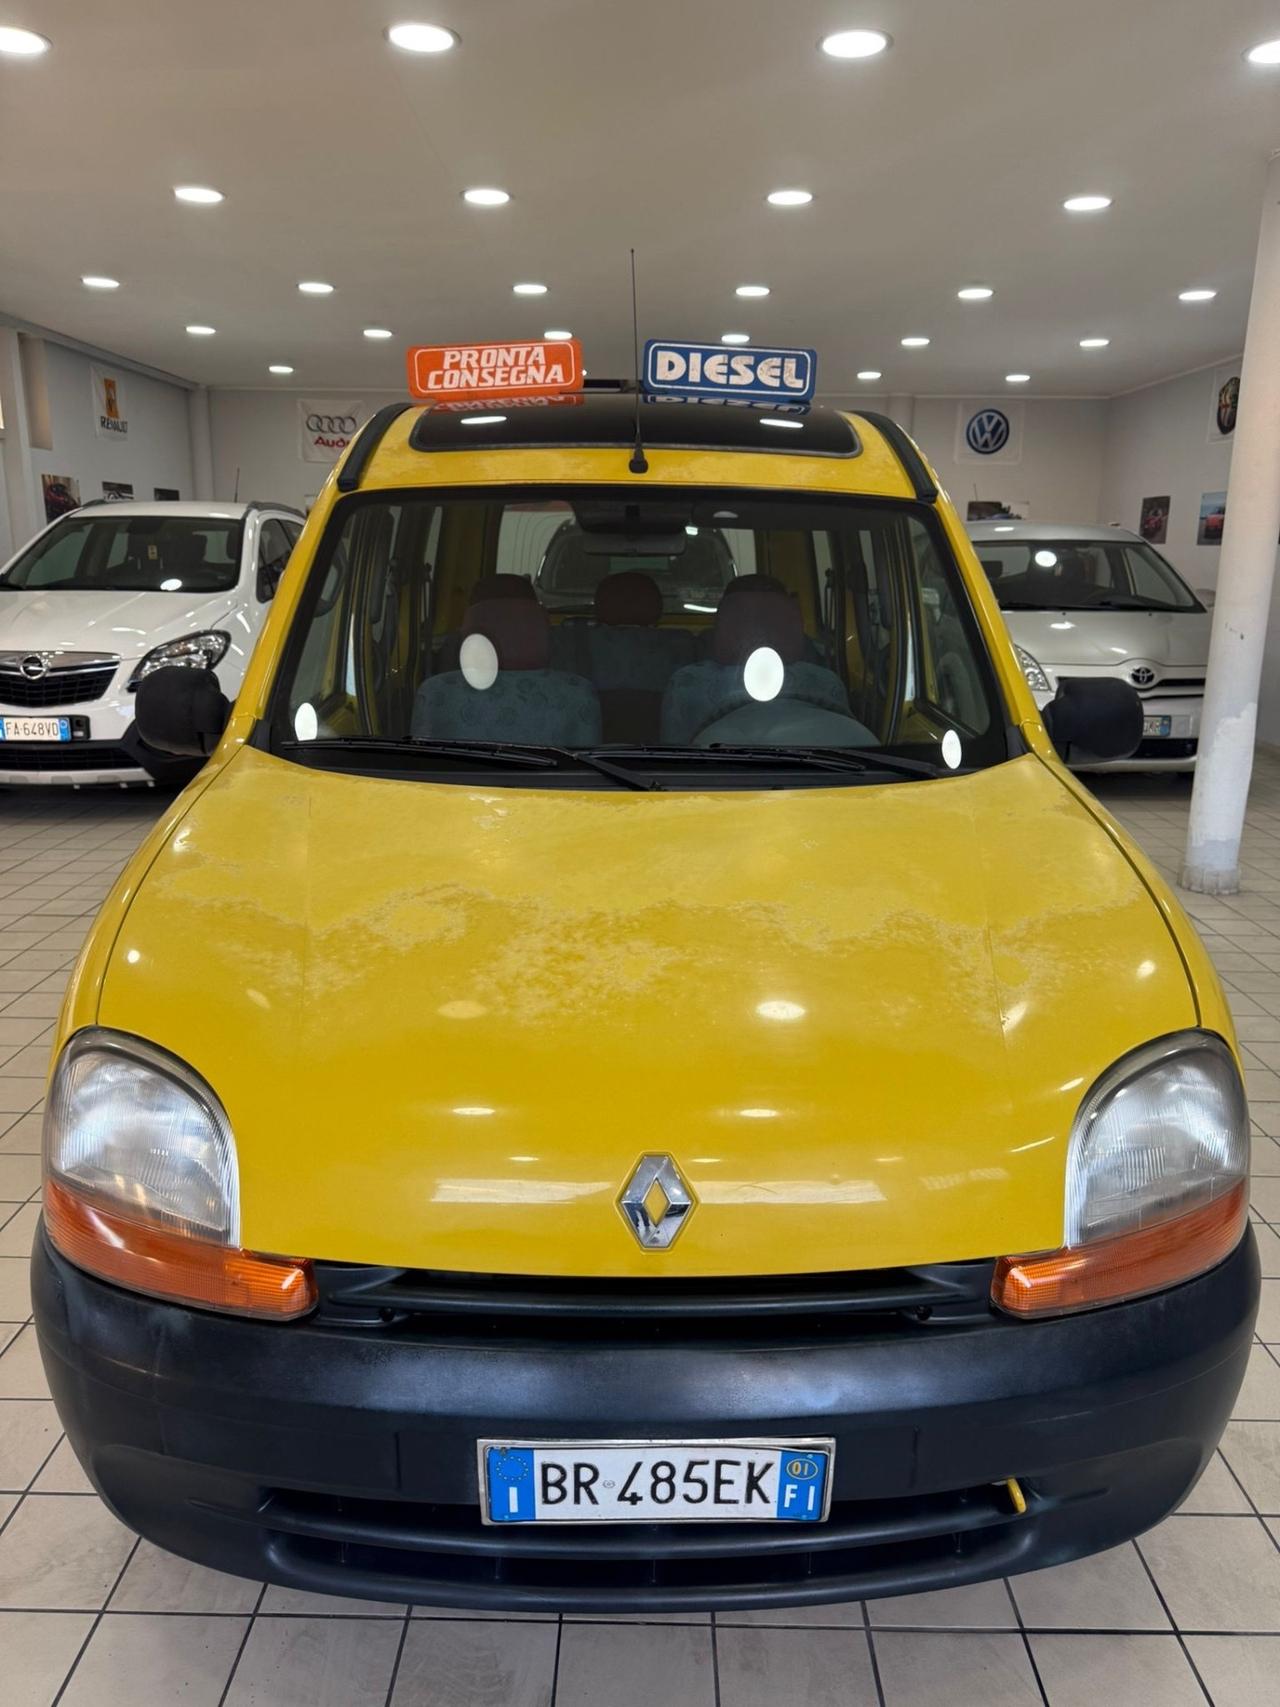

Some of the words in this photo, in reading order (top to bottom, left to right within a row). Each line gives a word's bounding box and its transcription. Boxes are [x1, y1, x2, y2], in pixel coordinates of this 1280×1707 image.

[444, 347, 545, 370] PRONTA
[657, 351, 803, 387] DIESEL
[427, 364, 564, 389] CONSEGNA
[540, 1462, 599, 1505] BR
[617, 1460, 773, 1505] 485EK
